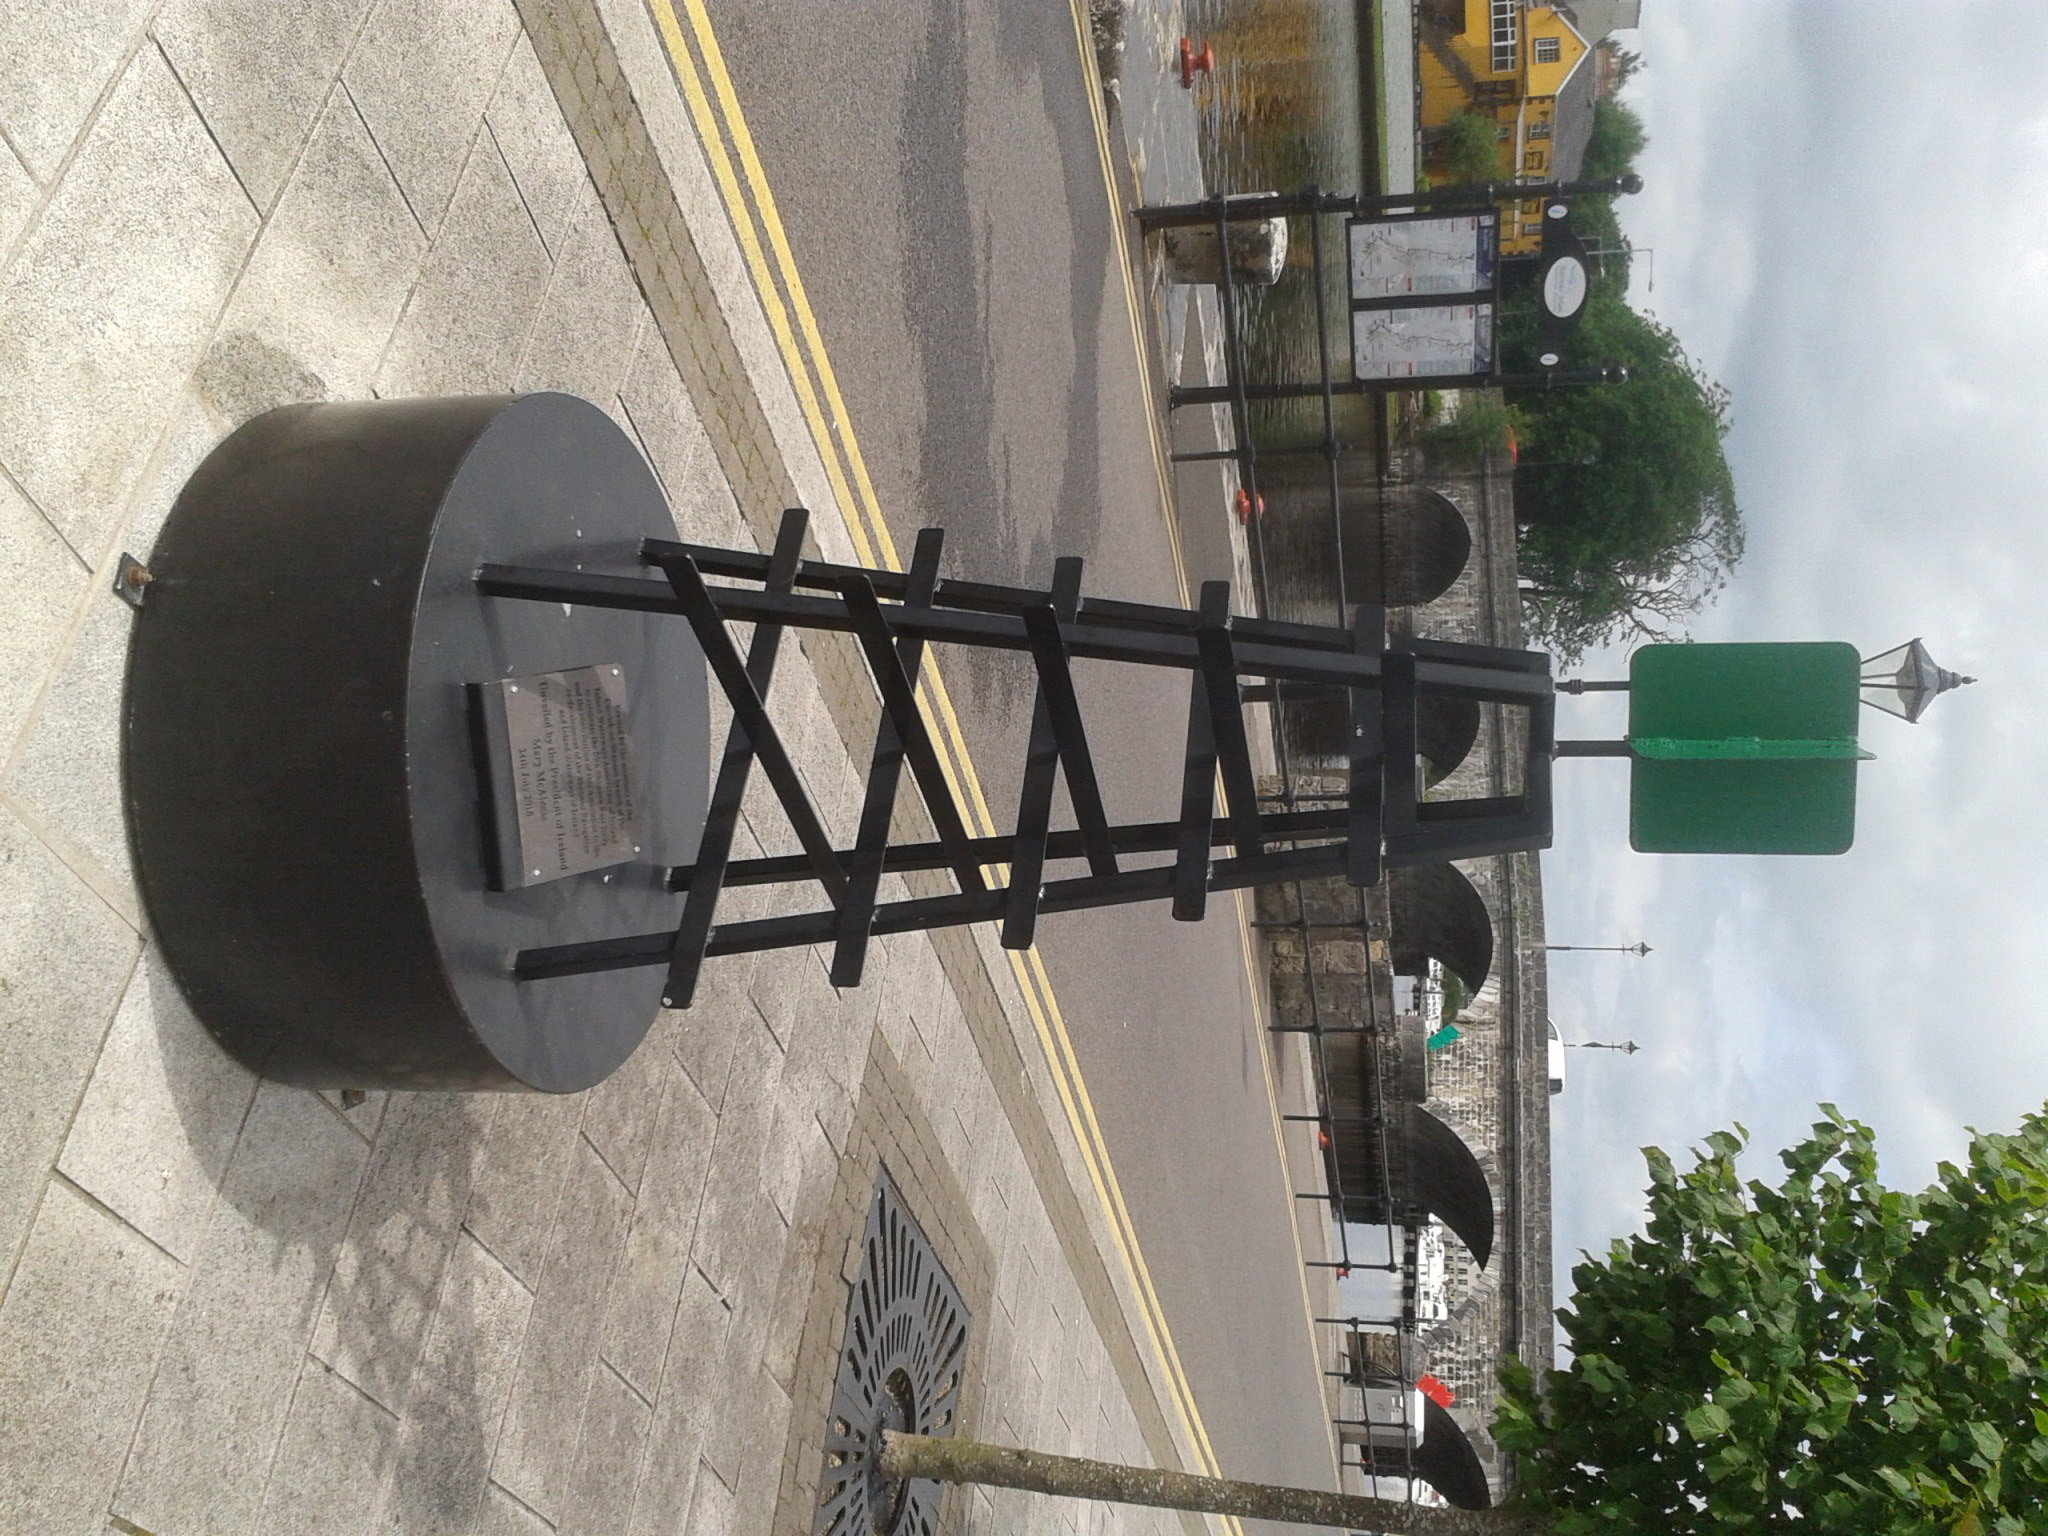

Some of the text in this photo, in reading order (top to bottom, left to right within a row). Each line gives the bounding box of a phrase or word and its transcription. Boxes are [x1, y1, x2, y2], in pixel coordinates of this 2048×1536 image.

[539, 682, 553, 728] Unveiled
[530, 739, 544, 768] Mary
[547, 748, 558, 764] the
[596, 716, 609, 760] Waterways
[549, 767, 564, 816] President
[556, 833, 570, 870] Ireland
